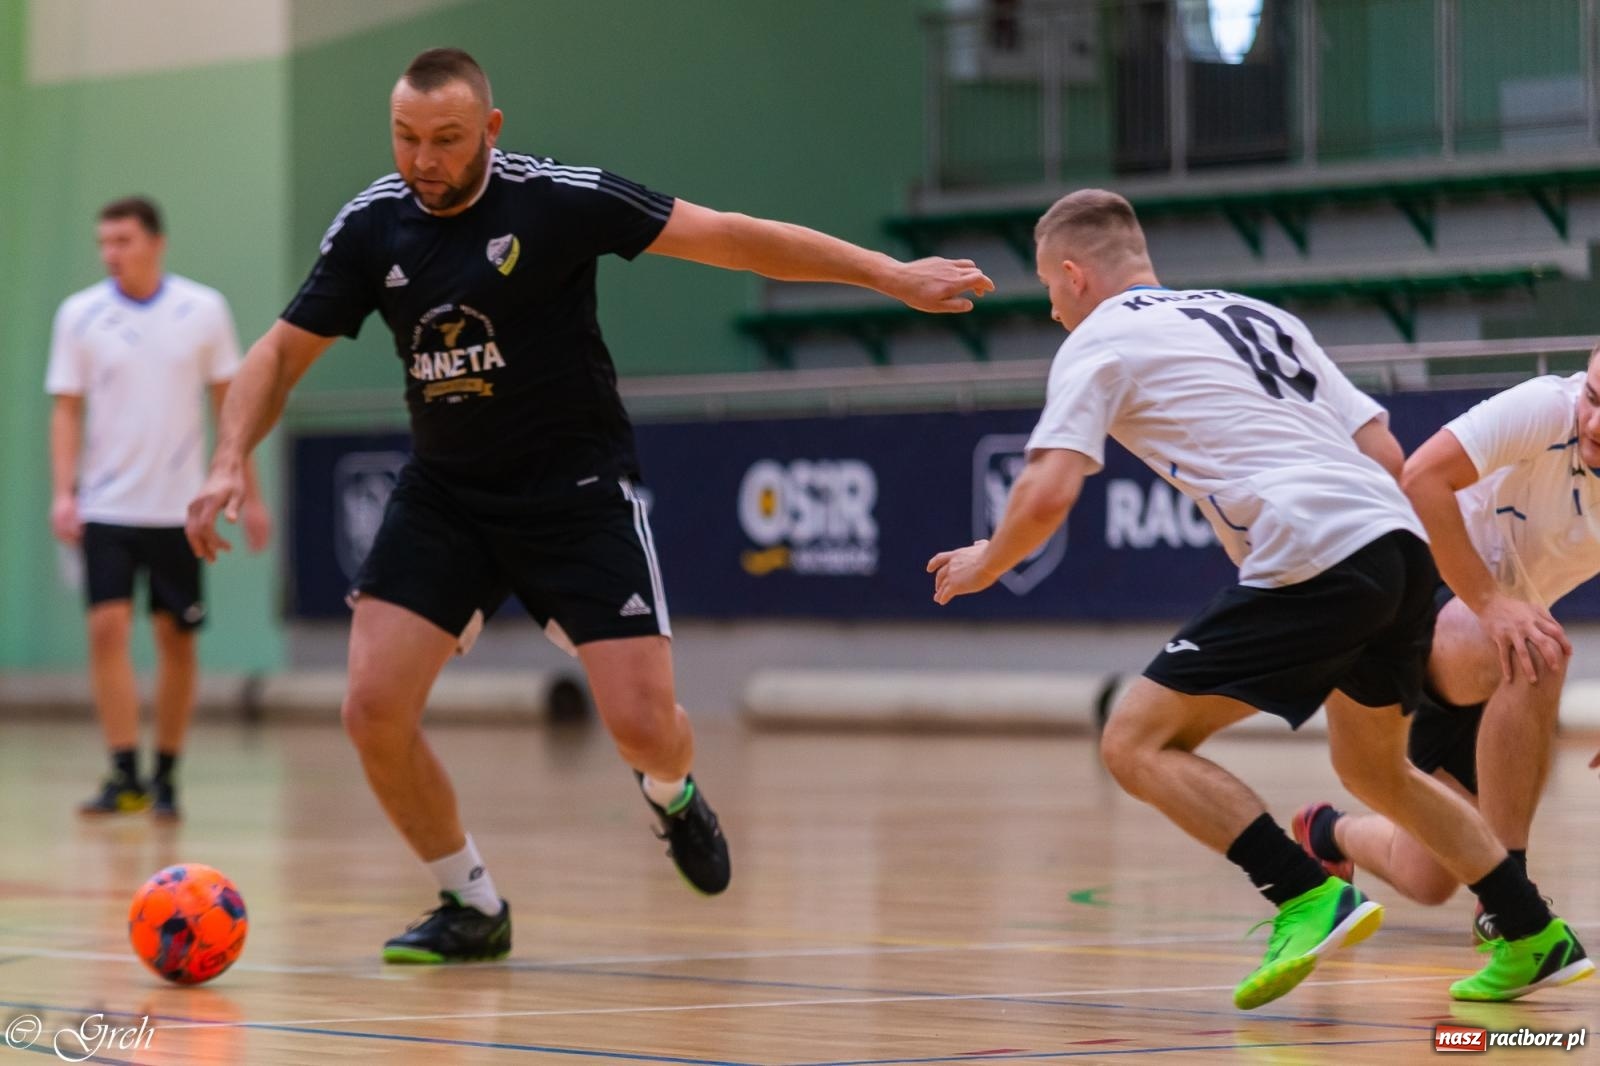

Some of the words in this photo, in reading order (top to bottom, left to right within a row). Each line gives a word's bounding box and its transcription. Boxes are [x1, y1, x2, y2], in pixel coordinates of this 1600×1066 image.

[409, 341, 506, 381] JANETA
[1176, 304, 1318, 403] 10
[1105, 478, 1222, 549] RAC
